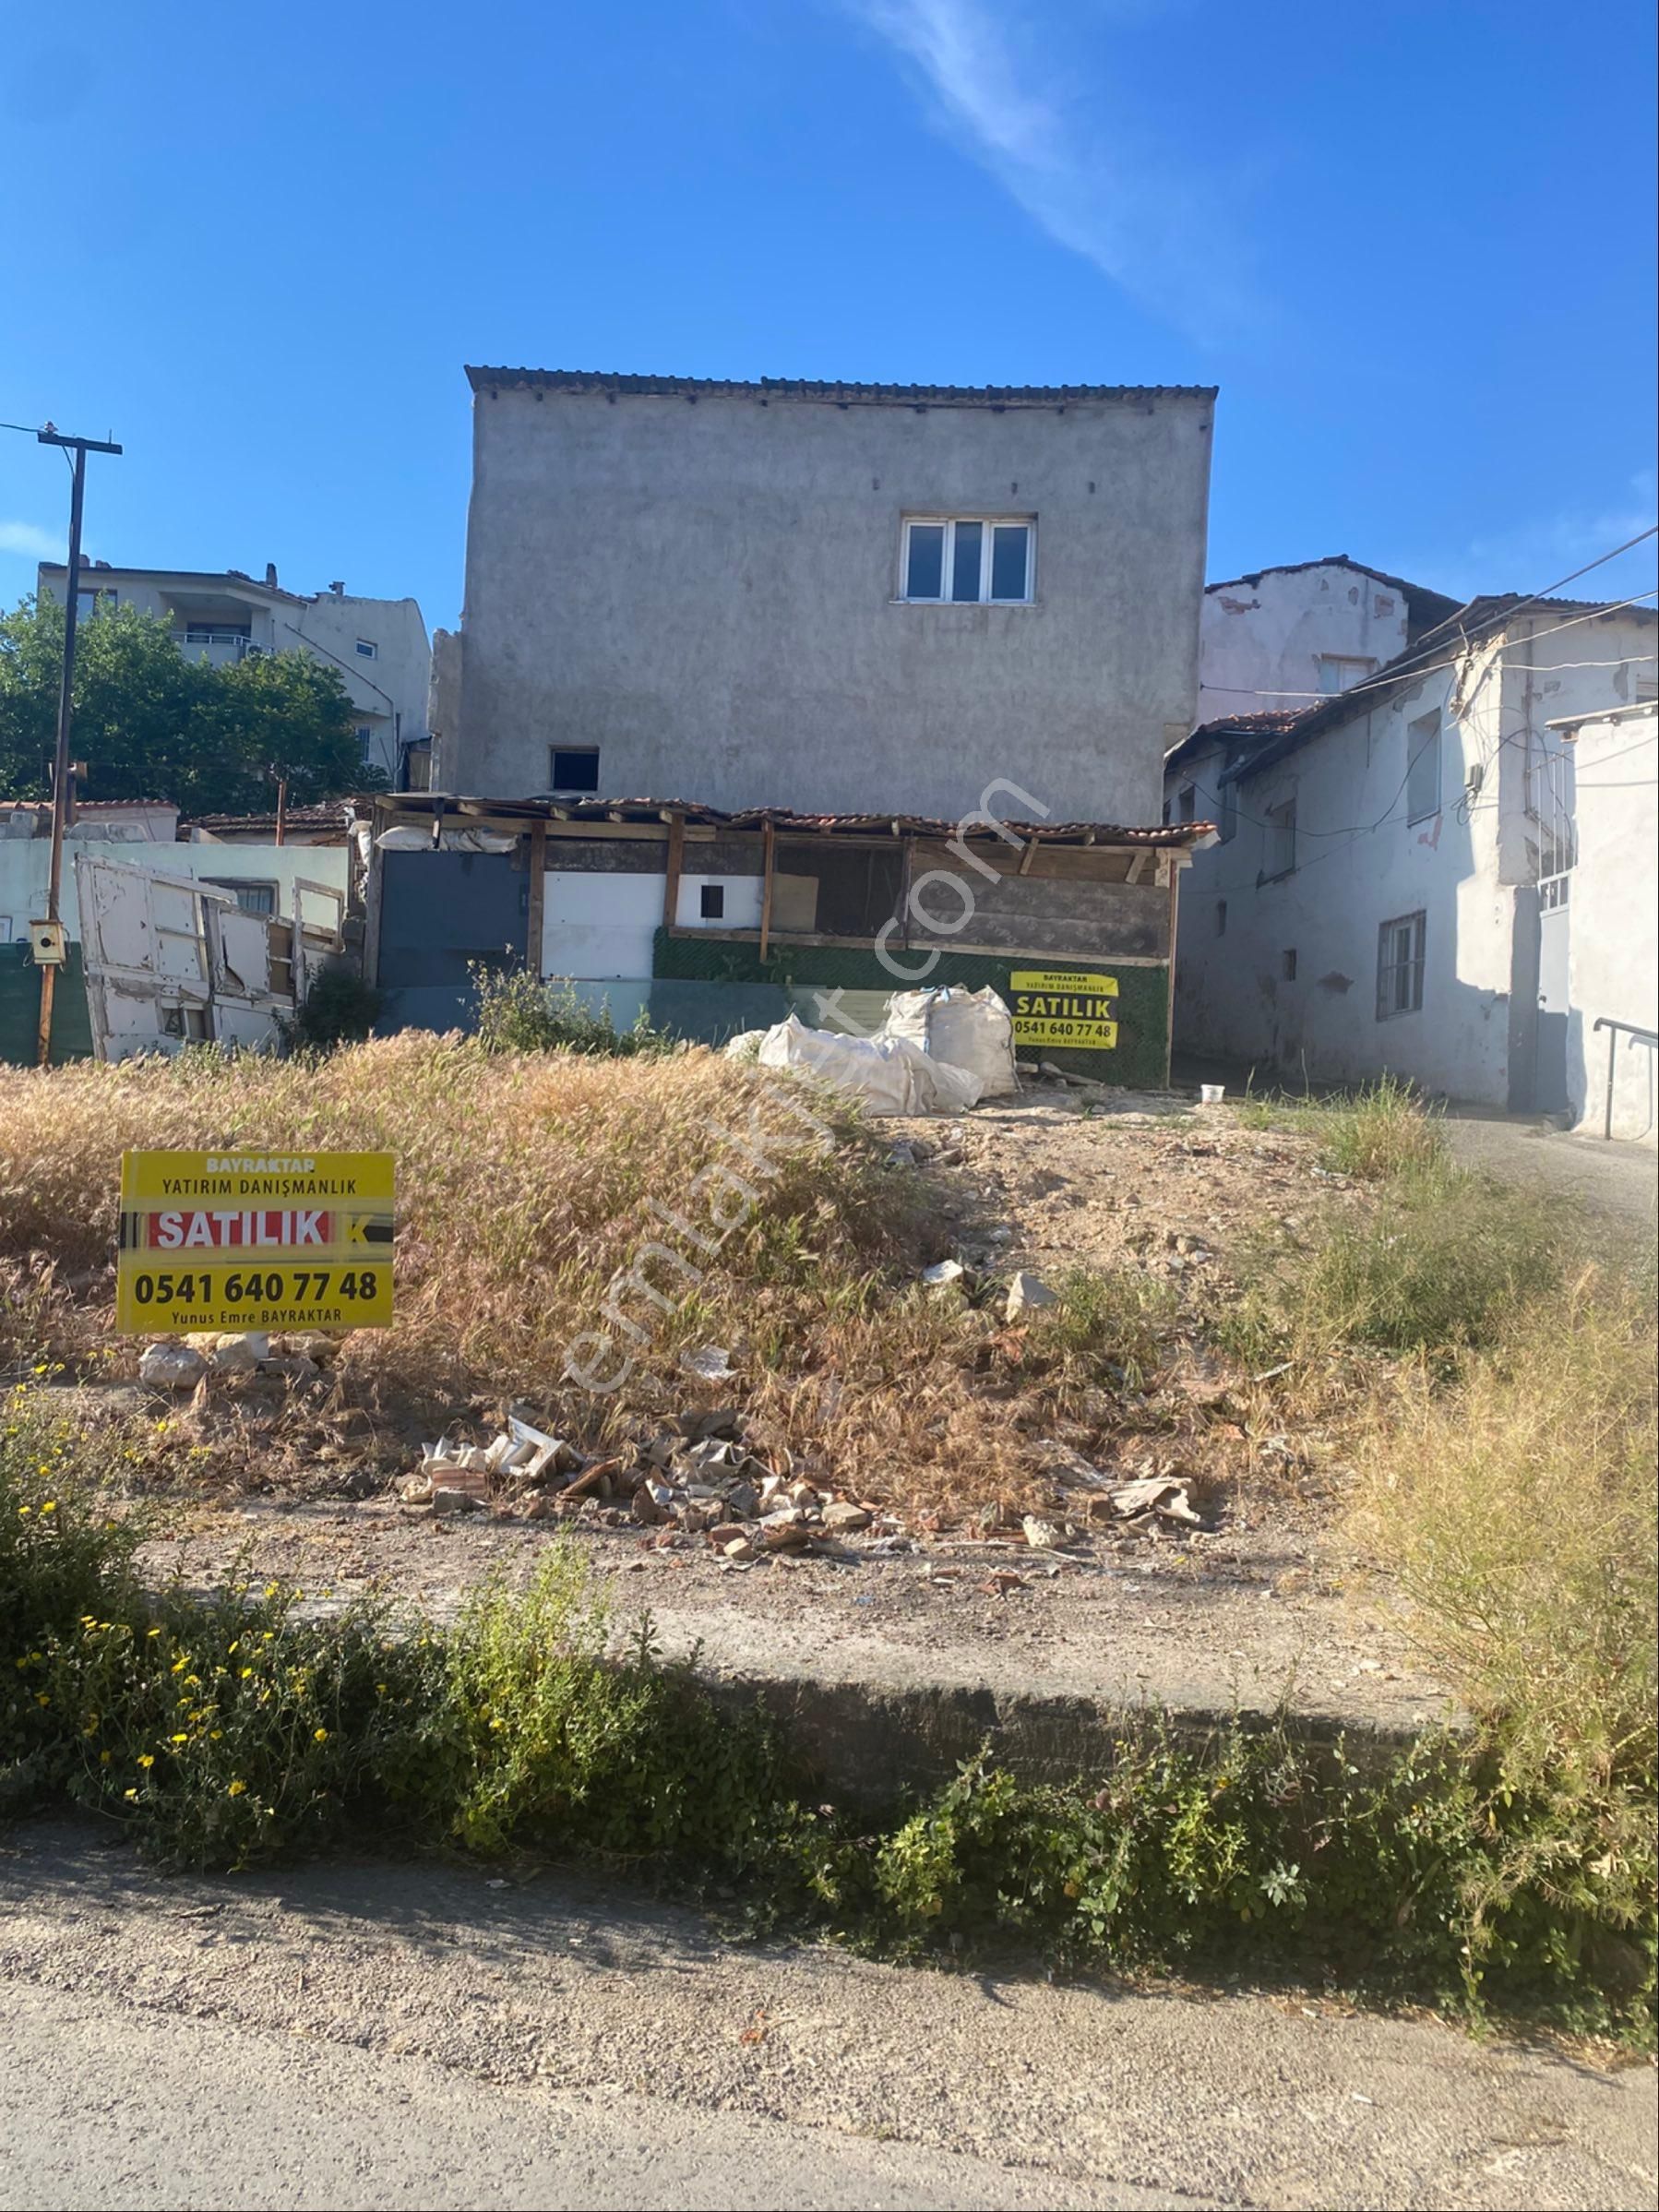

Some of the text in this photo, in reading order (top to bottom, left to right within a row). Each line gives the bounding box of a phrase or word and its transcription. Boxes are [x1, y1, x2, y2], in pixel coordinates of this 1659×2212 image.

[1044, 974, 1087, 983] BAYRAKTAR
[1017, 996, 1111, 1018] SATILIK
[1015, 1021, 1111, 1037] 0541 640 77 48
[207, 1158, 316, 1173] BAYRAKTAR
[162, 1178, 357, 1198] YATIRIM DANIŞMANLIK
[158, 1211, 324, 1249] SATILIK
[135, 1272, 376, 1304] 0541 640 77 48
[172, 1309, 341, 1324] Yunus Emre BAYRAKTAR
